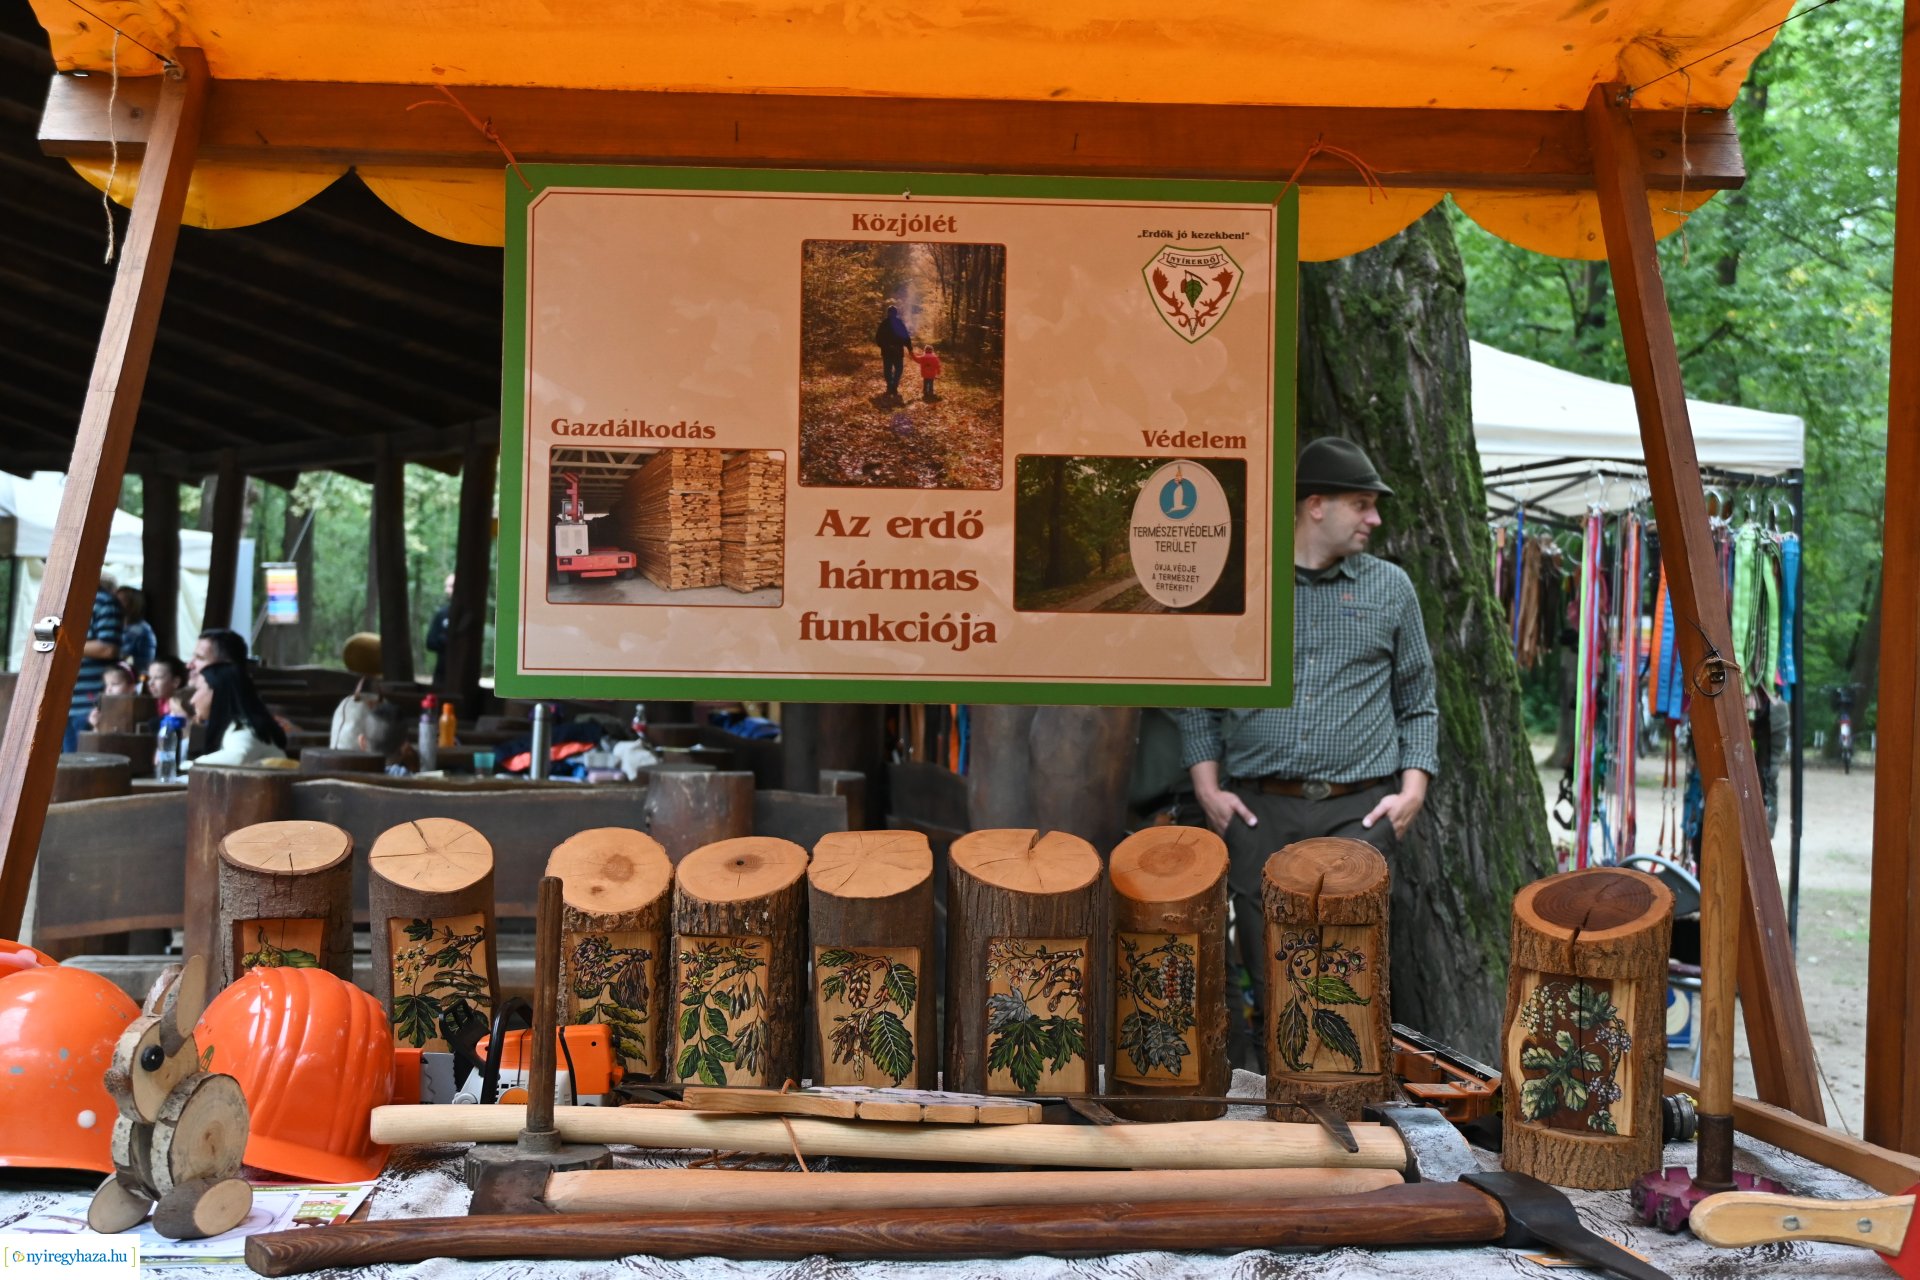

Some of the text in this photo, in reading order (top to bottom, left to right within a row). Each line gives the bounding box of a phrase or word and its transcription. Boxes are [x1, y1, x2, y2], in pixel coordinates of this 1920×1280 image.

[851, 213, 958, 237] Közjólét
[1176, 230, 1187, 240] jó
[551, 418, 717, 439] Gazdálkodás
[1141, 429, 1247, 449] Védelem
[814, 509, 984, 540] Az erdő
[1133, 523, 1227, 538] TERMÉSZETVÉDELMI
[1155, 538, 1197, 553] TERÜLET
[818, 560, 979, 592] hármas
[1152, 572, 1200, 583] A TERMÉSZET
[798, 611, 998, 652] funkciója
